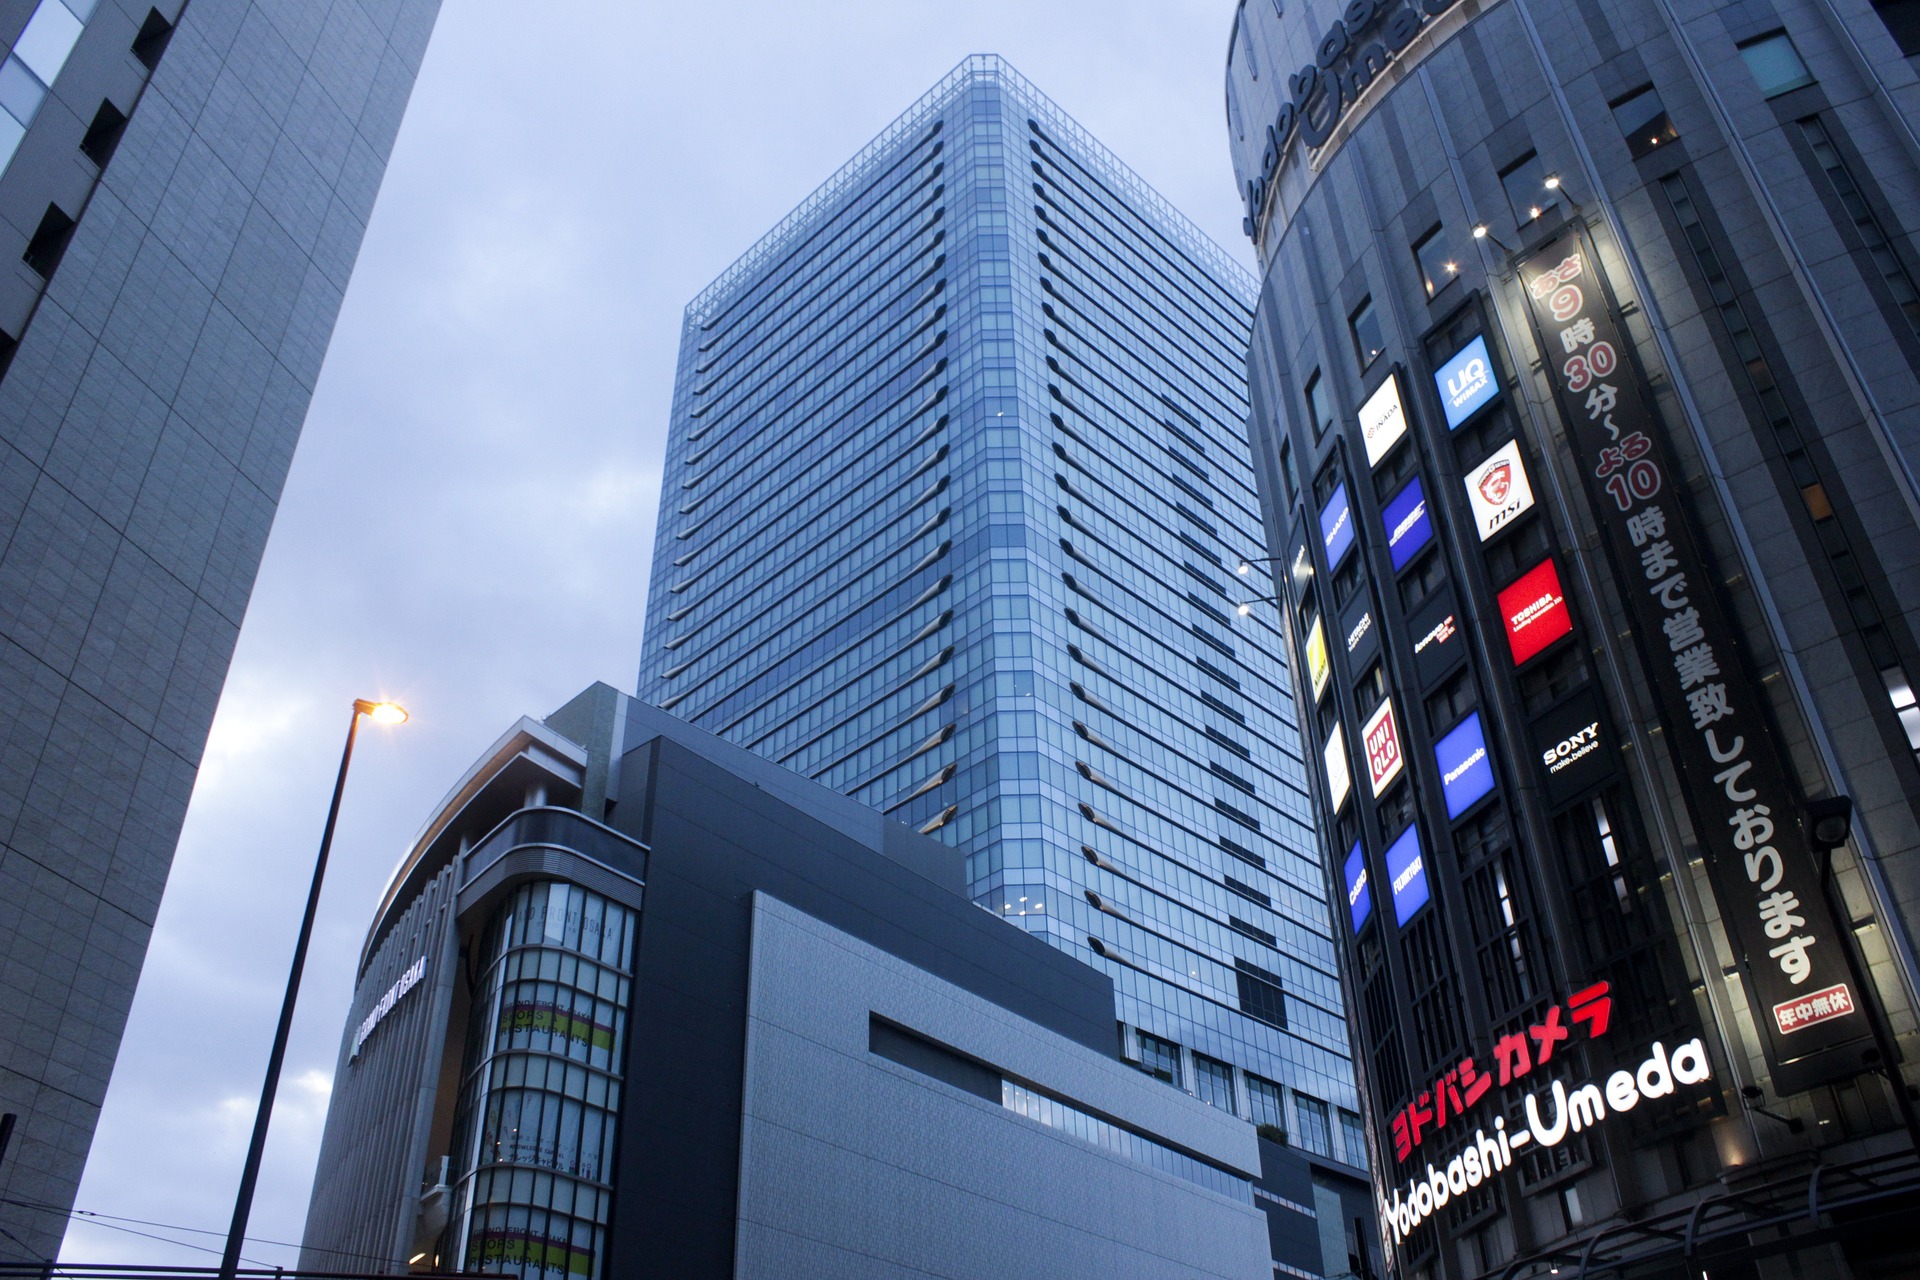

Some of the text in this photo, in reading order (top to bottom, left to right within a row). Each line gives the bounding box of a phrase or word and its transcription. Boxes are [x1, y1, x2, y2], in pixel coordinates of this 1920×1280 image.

[1447, 358, 1484, 397] UQ
[1375, 404, 1398, 431] INADA
[1325, 506, 1349, 546] SHARP
[1489, 498, 1521, 530] msi
[1511, 593, 1553, 626] TOSHIBA
[1347, 612, 1370, 646] HITACHI
[1414, 624, 1444, 653] lenovo
[1369, 720, 1390, 756] UNI
[1543, 722, 1599, 766] SONY
[1373, 740, 1395, 776] QLO
[1443, 747, 1486, 786] Panasonic
[1550, 740, 1599, 774] make.believe
[1349, 868, 1367, 906] CASIO
[583, 916, 613, 942] OSAA
[502, 1010, 544, 1024] SOPS
[1778, 991, 1849, 1026] 年中無休
[500, 1023, 590, 1048] RSTAURANTS
[1392, 979, 1612, 1164] ヨドバシカメラ
[1383, 1036, 1711, 1246] Yodobashi-Umeda
[471, 1239, 516, 1252] SOPS
[470, 1253, 566, 1276] RSTAURANTS
